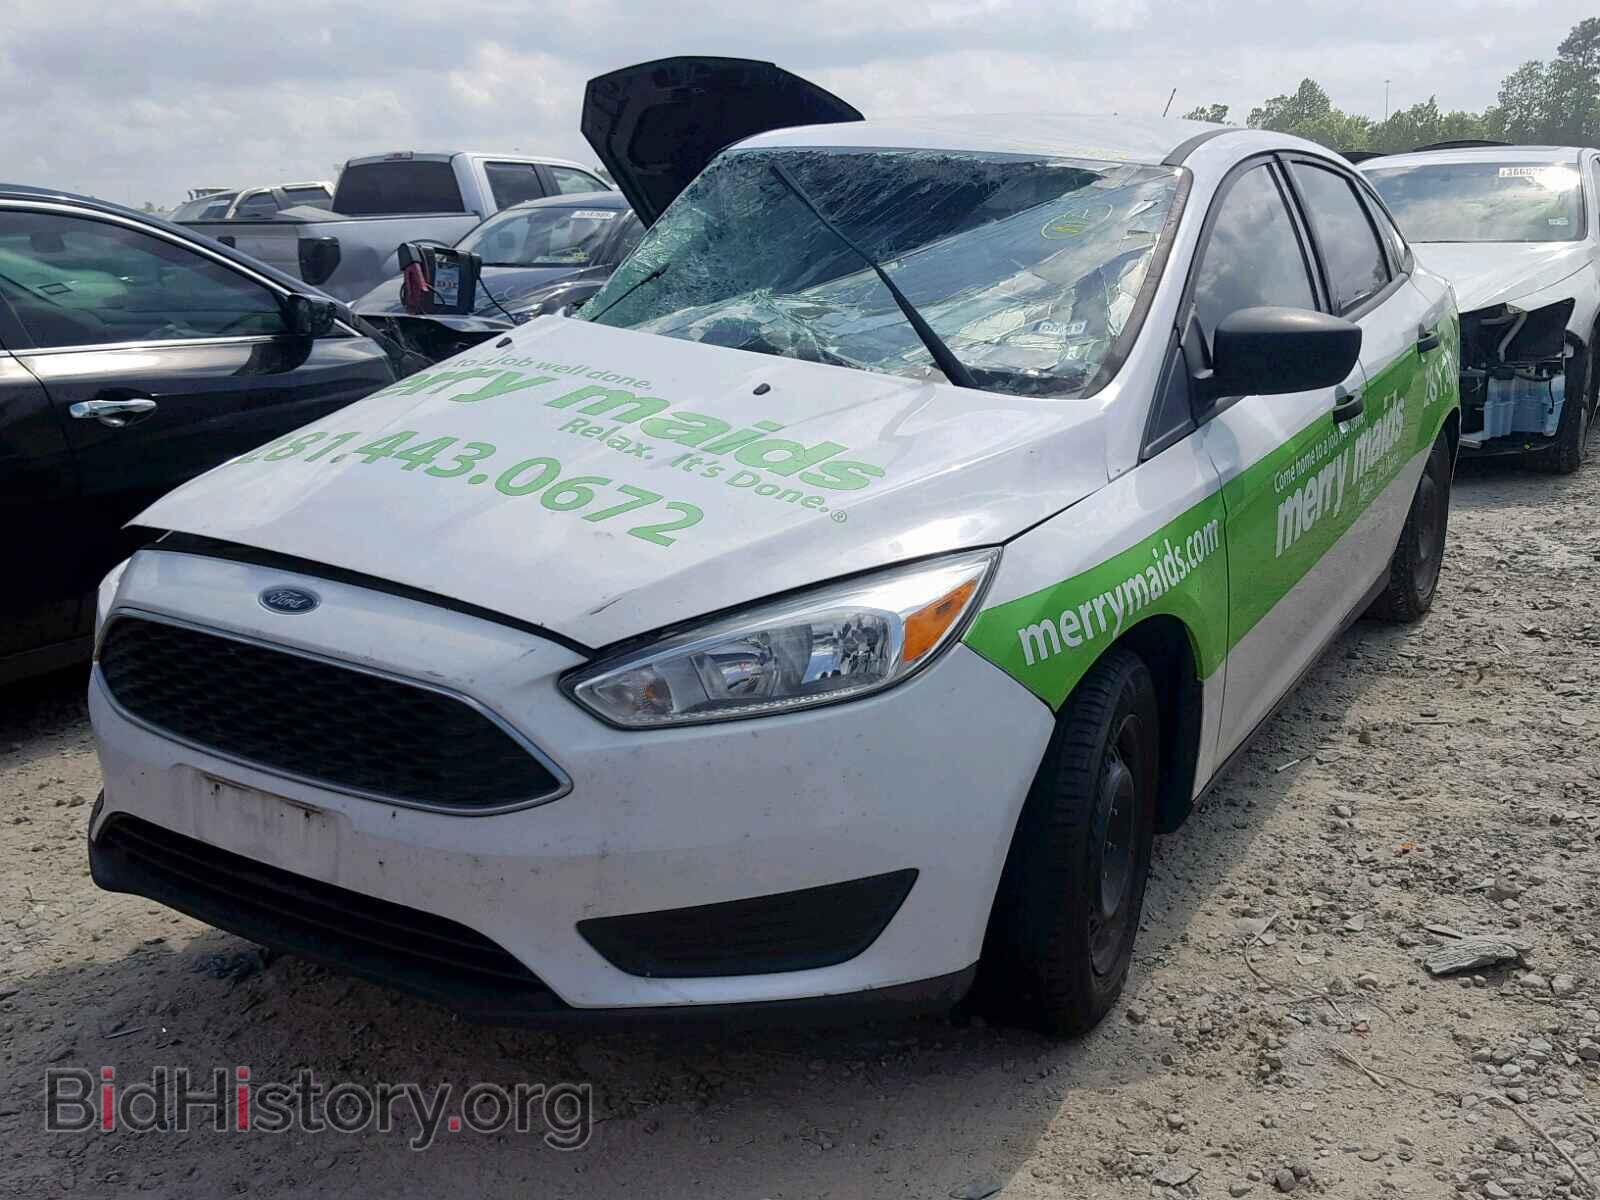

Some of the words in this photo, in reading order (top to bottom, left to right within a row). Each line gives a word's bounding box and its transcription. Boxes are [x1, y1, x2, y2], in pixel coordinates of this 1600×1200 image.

[535, 360, 590, 376] well
[366, 368, 557, 403] erry
[544, 384, 886, 491] maids
[558, 416, 655, 460] Relax.
[670, 451, 726, 479] It's
[1274, 470, 1295, 493] Come
[1295, 455, 1314, 477] home
[1276, 447, 1349, 558] merry
[1352, 388, 1405, 485] maids
[1018, 519, 1219, 666] merrymaids.com
